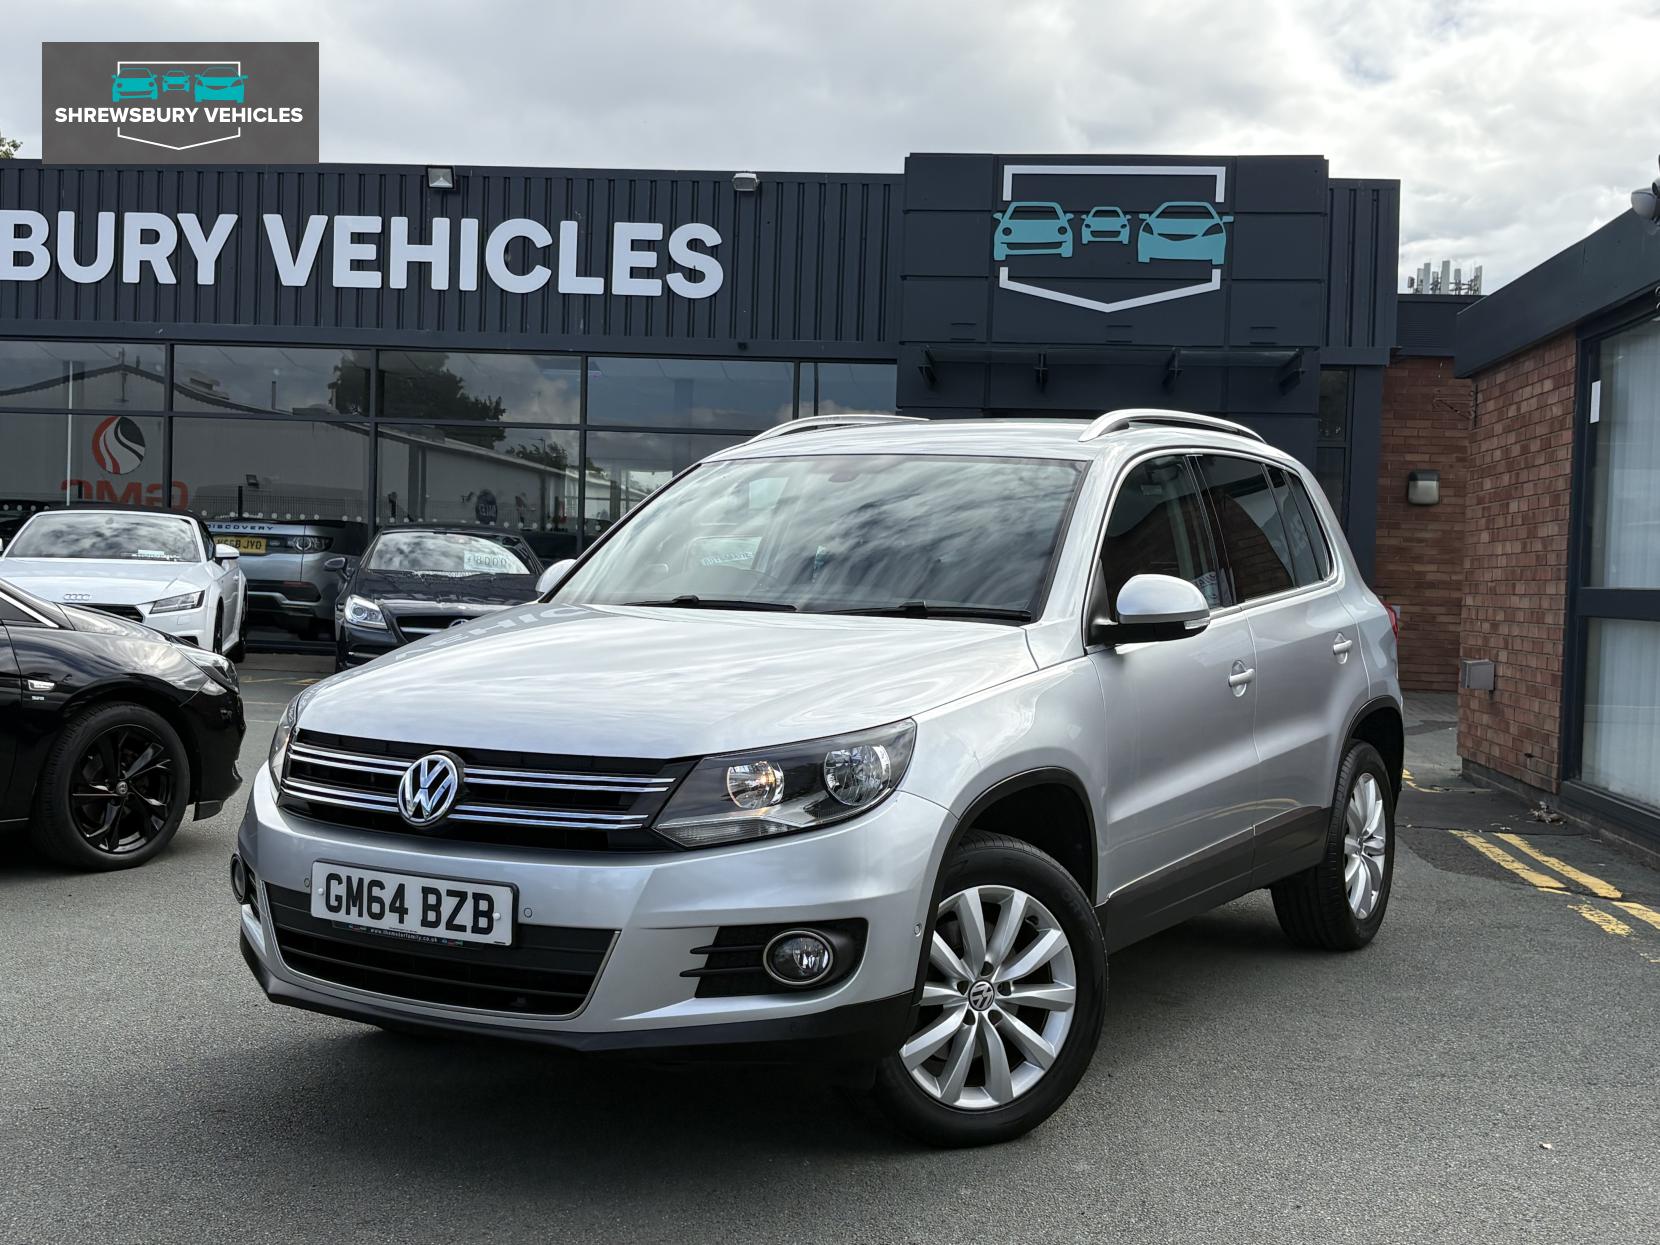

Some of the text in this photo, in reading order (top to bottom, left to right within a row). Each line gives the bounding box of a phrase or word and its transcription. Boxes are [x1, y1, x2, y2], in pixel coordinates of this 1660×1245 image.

[0, 209, 724, 299] BURY VEHICLES
[325, 872, 495, 935] GM64 BZB
